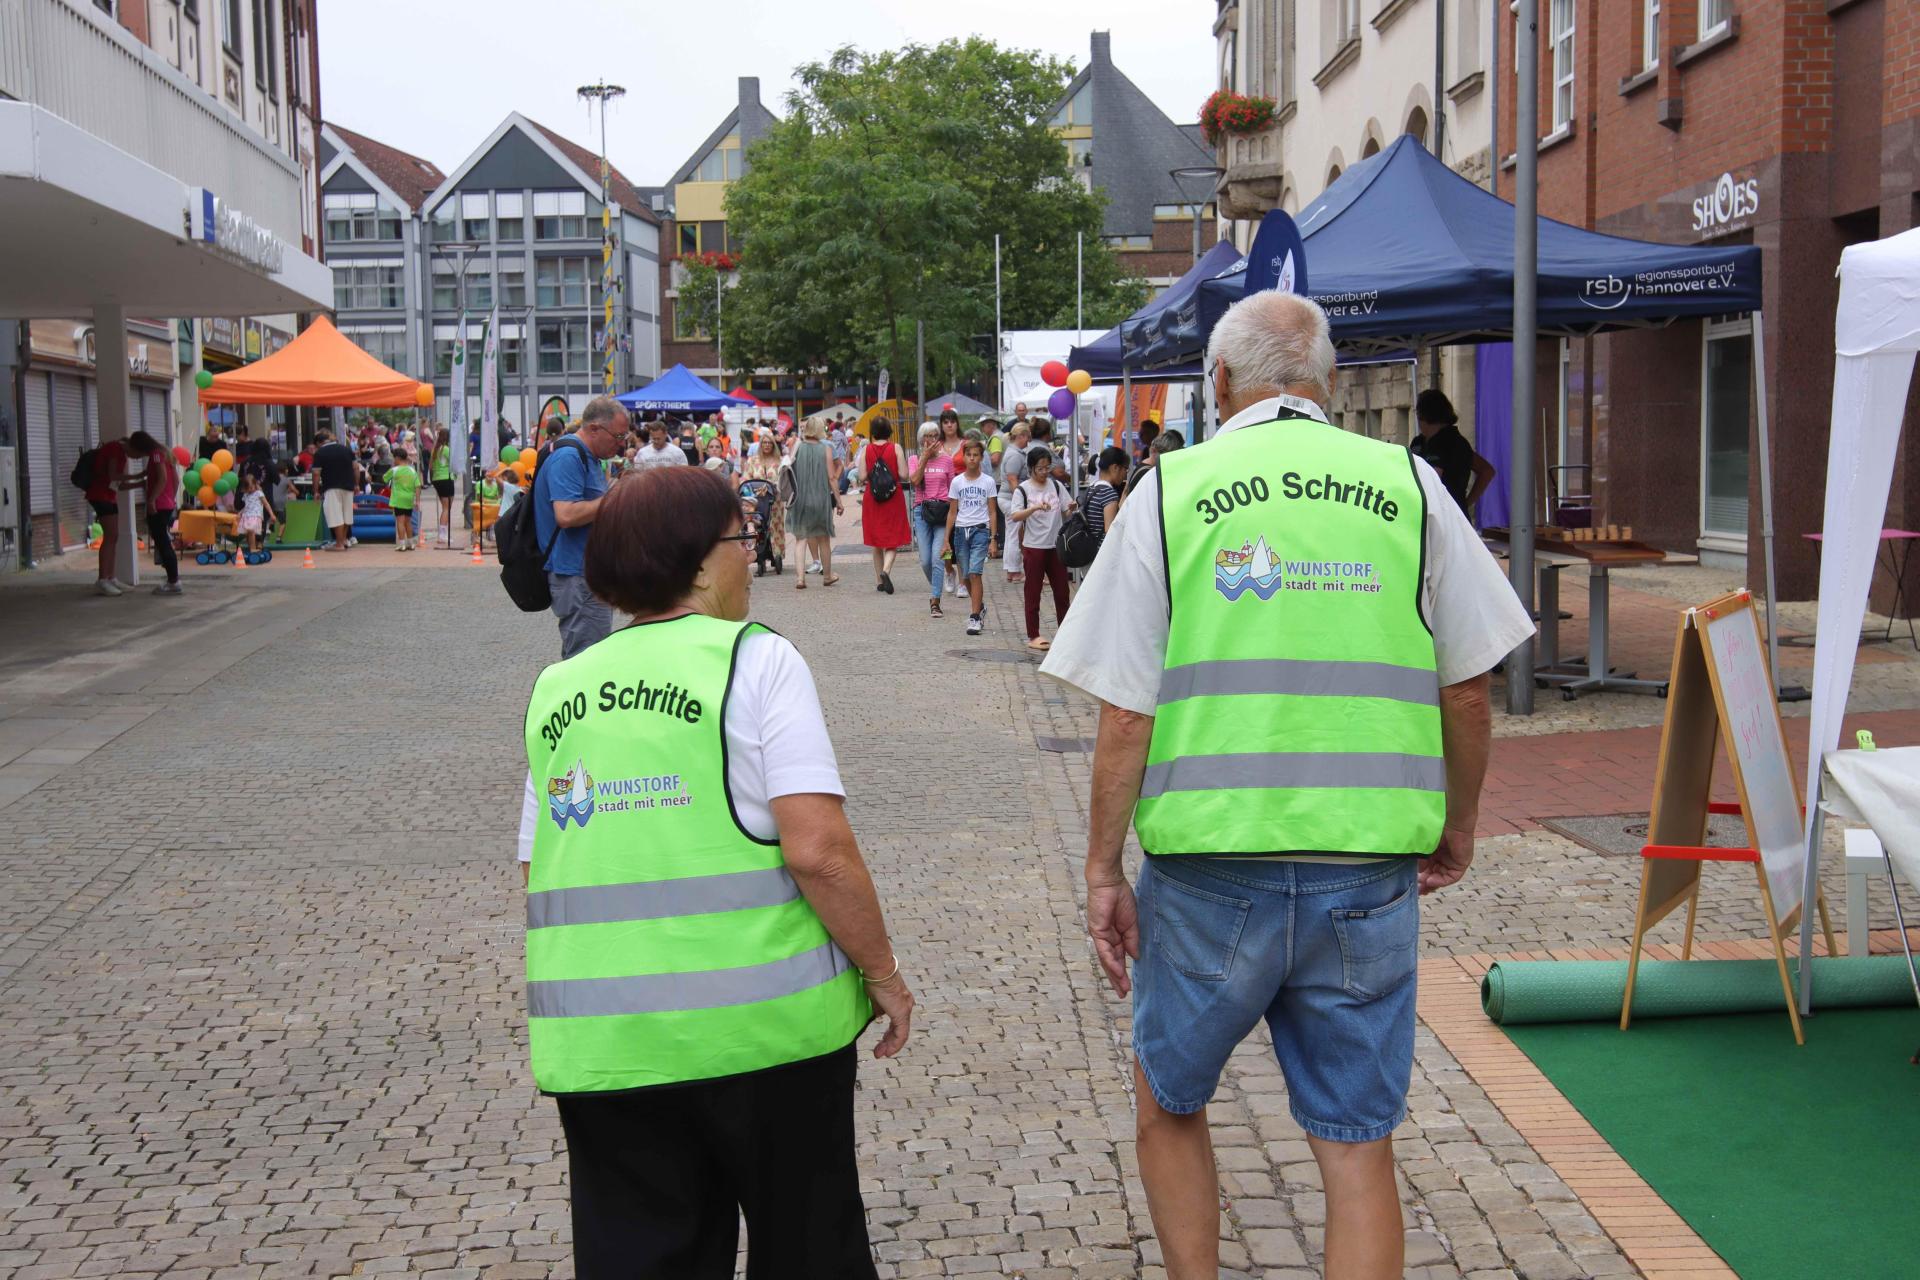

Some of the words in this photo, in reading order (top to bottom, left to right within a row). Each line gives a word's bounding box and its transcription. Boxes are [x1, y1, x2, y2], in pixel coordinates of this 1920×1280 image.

[1693, 172, 1758, 231] SHOES
[1586, 274, 1624, 296] rsb
[1635, 261, 1735, 283] regionssportbund
[1635, 279, 1705, 296] hannover
[1708, 274, 1736, 289] e.V.
[1350, 301, 1378, 316] e.V.
[635, 400, 691, 410] SPORT-THIEME
[1196, 476, 1269, 524] 3000
[1282, 472, 1398, 522] Schritte
[1285, 560, 1372, 577] WUNSTORF
[1285, 579, 1317, 591] stadt
[1323, 580, 1345, 591] mit
[1351, 581, 1382, 592] meer
[541, 691, 586, 752] 3000
[598, 680, 702, 723] Schritte
[598, 775, 680, 796] WUNSTORF
[598, 798, 629, 812] stadt
[634, 797, 655, 809] mit
[661, 795, 692, 807] meer
